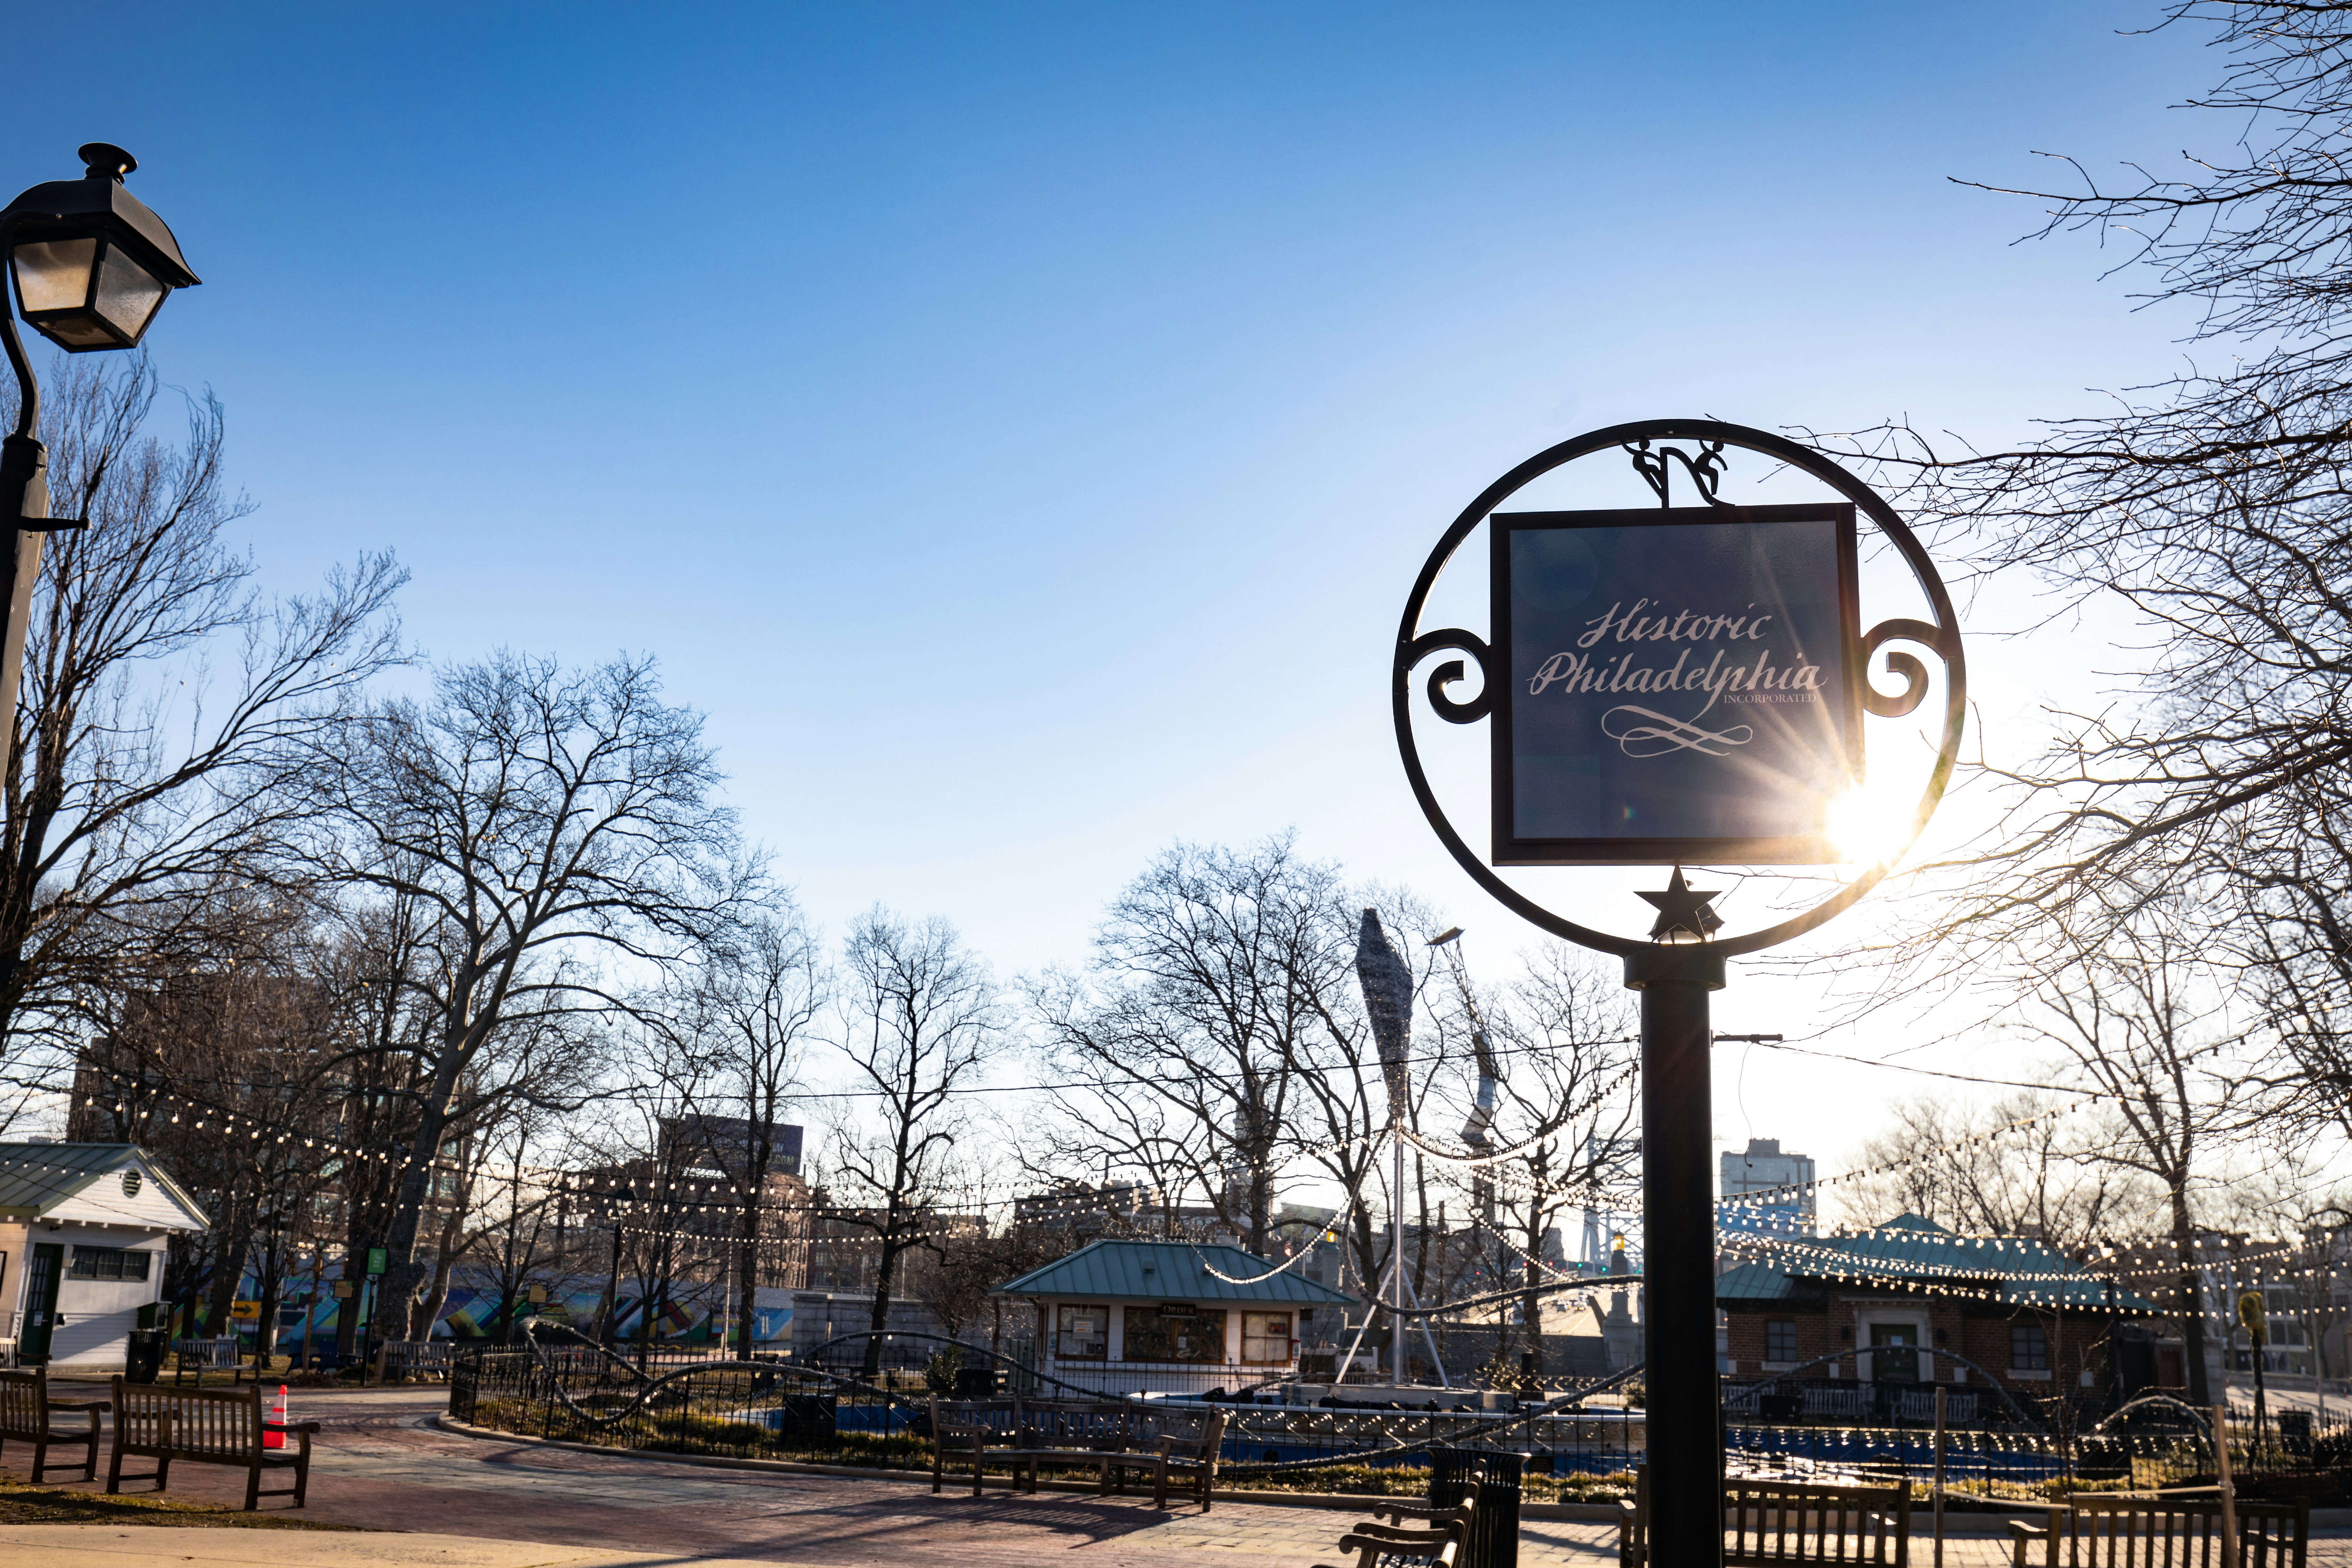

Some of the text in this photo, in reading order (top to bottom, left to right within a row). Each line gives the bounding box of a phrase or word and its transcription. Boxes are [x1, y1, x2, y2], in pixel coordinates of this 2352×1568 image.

[1577, 598, 1772, 648] Historic
[1525, 647, 1828, 713] Philadelphia
[1723, 693, 1817, 703] INCORPORATED
[1163, 1305, 1194, 1314] ORDER
